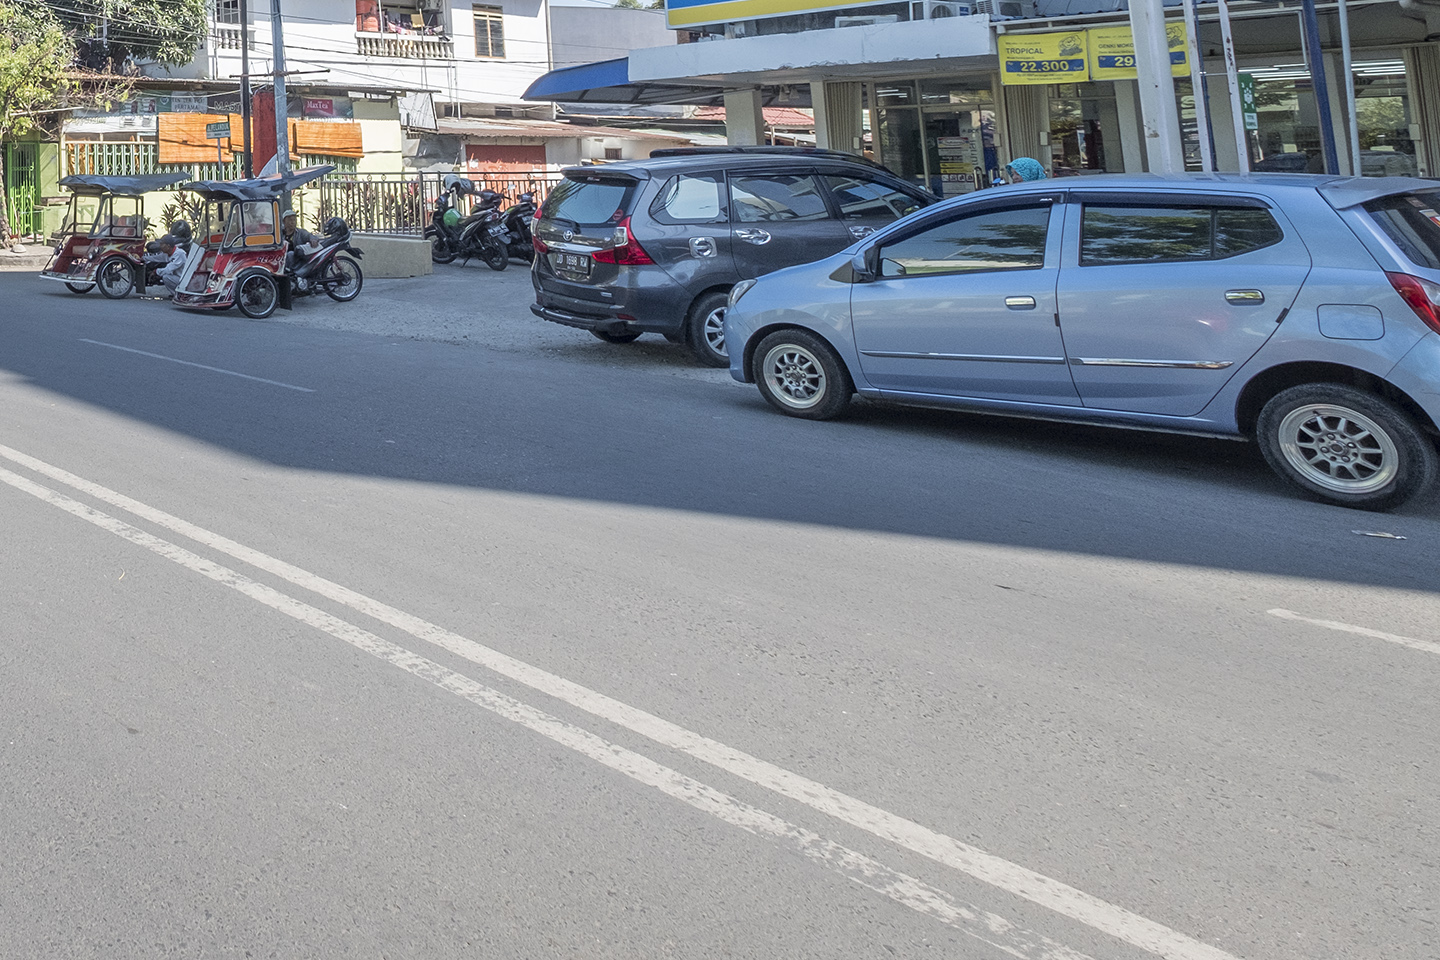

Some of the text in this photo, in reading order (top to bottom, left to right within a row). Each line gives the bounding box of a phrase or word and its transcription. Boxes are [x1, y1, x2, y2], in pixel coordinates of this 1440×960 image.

[1006, 47, 1044, 55] TROPICAL
[1020, 61, 1069, 72] 22.300
[307, 101, 328, 109] MaxTea
